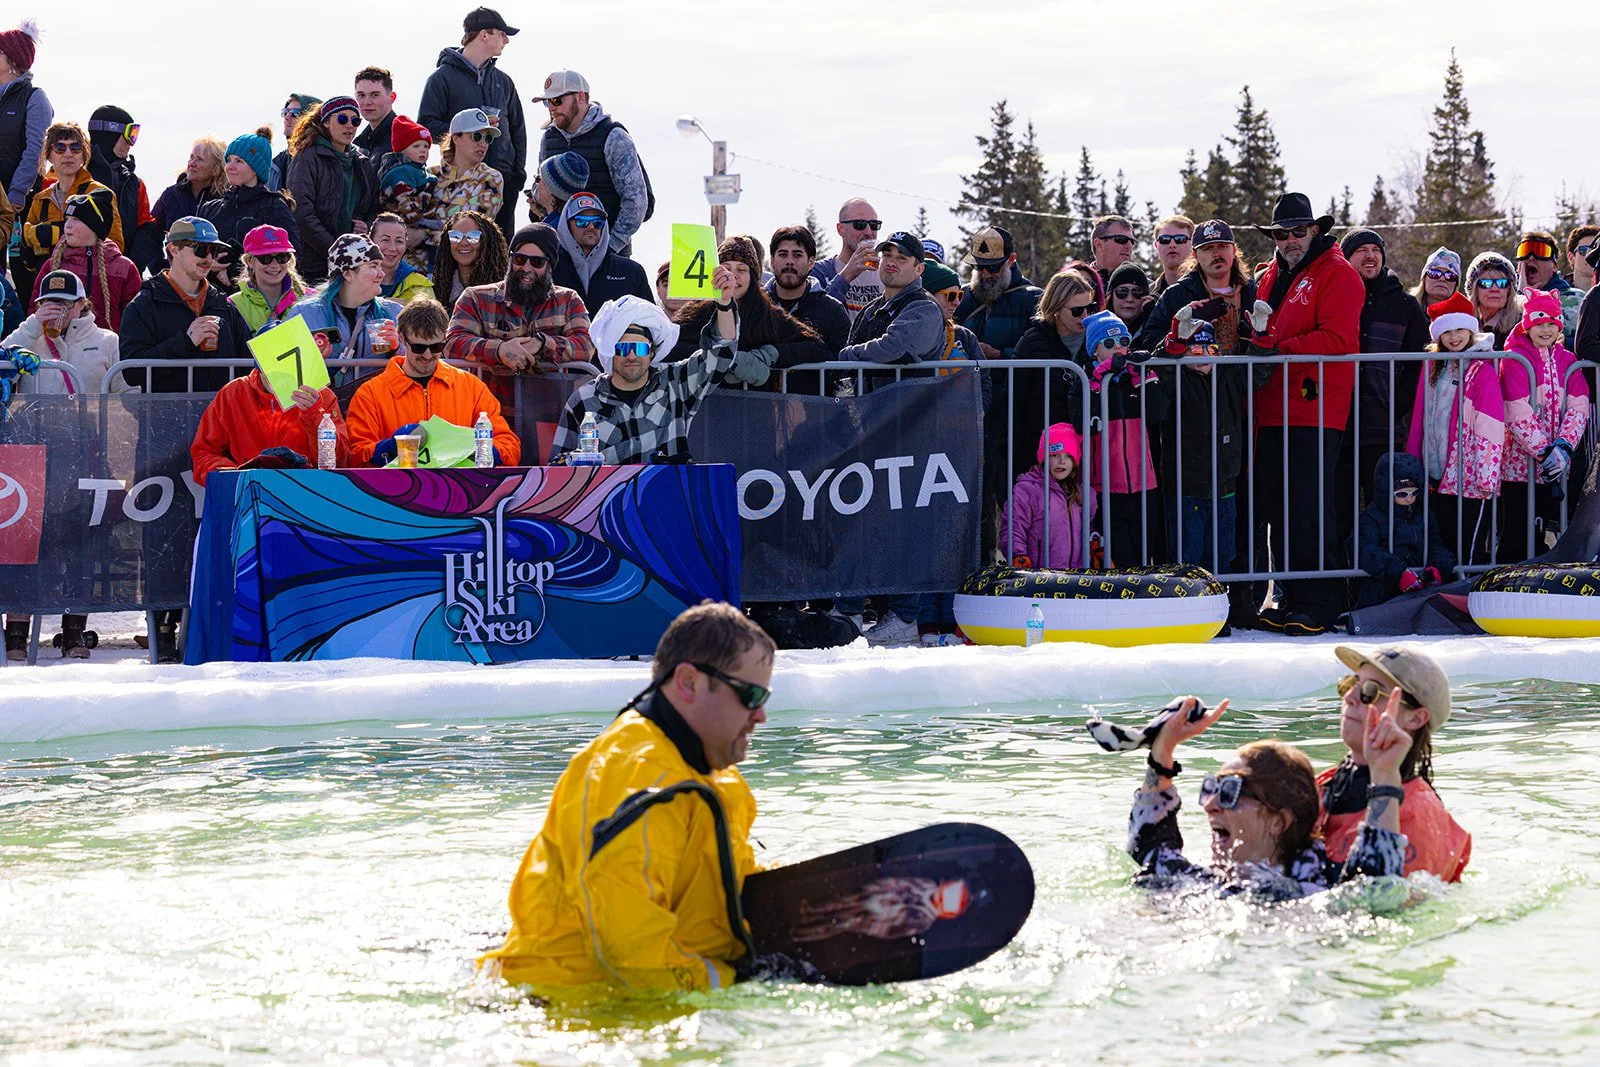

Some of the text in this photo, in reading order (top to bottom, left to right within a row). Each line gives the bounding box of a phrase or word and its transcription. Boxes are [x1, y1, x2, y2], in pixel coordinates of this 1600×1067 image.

[683, 250, 709, 288] 4
[276, 347, 304, 387] 7
[78, 469, 206, 527] TOY
[737, 452, 970, 521] OYOTA
[443, 496, 555, 606] Hilltop
[457, 578, 516, 619] Ski
[454, 612, 533, 644] Area
